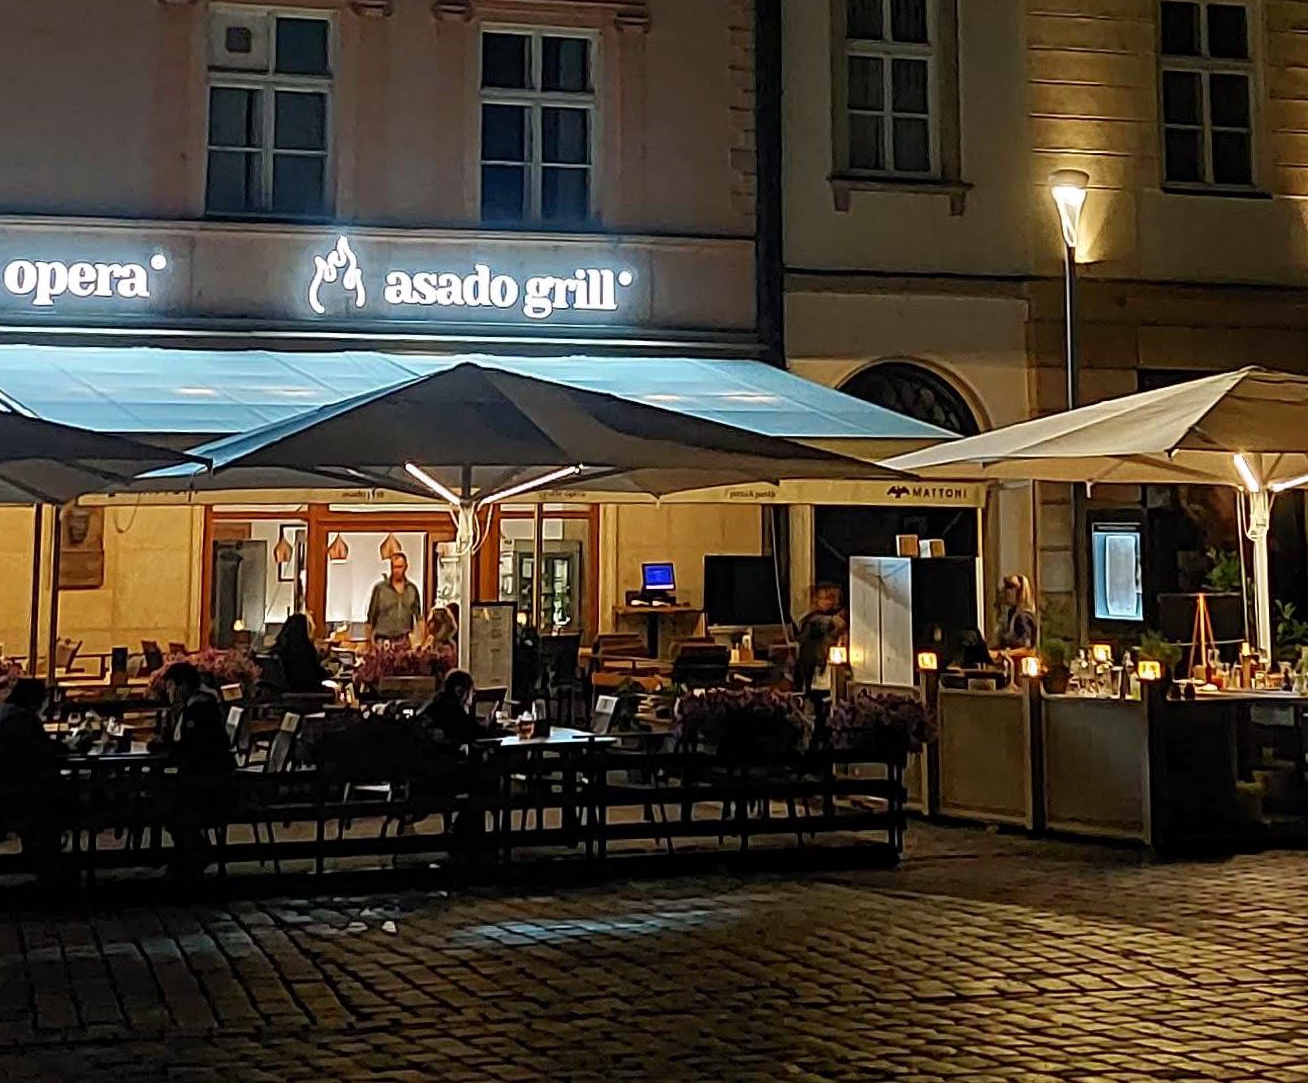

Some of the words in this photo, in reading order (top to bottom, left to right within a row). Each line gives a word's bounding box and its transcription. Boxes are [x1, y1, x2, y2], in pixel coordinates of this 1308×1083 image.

[2, 258, 152, 307] opera
[384, 263, 519, 309] asado
[523, 268, 619, 319] grill
[912, 487, 968, 499] MATTONI
